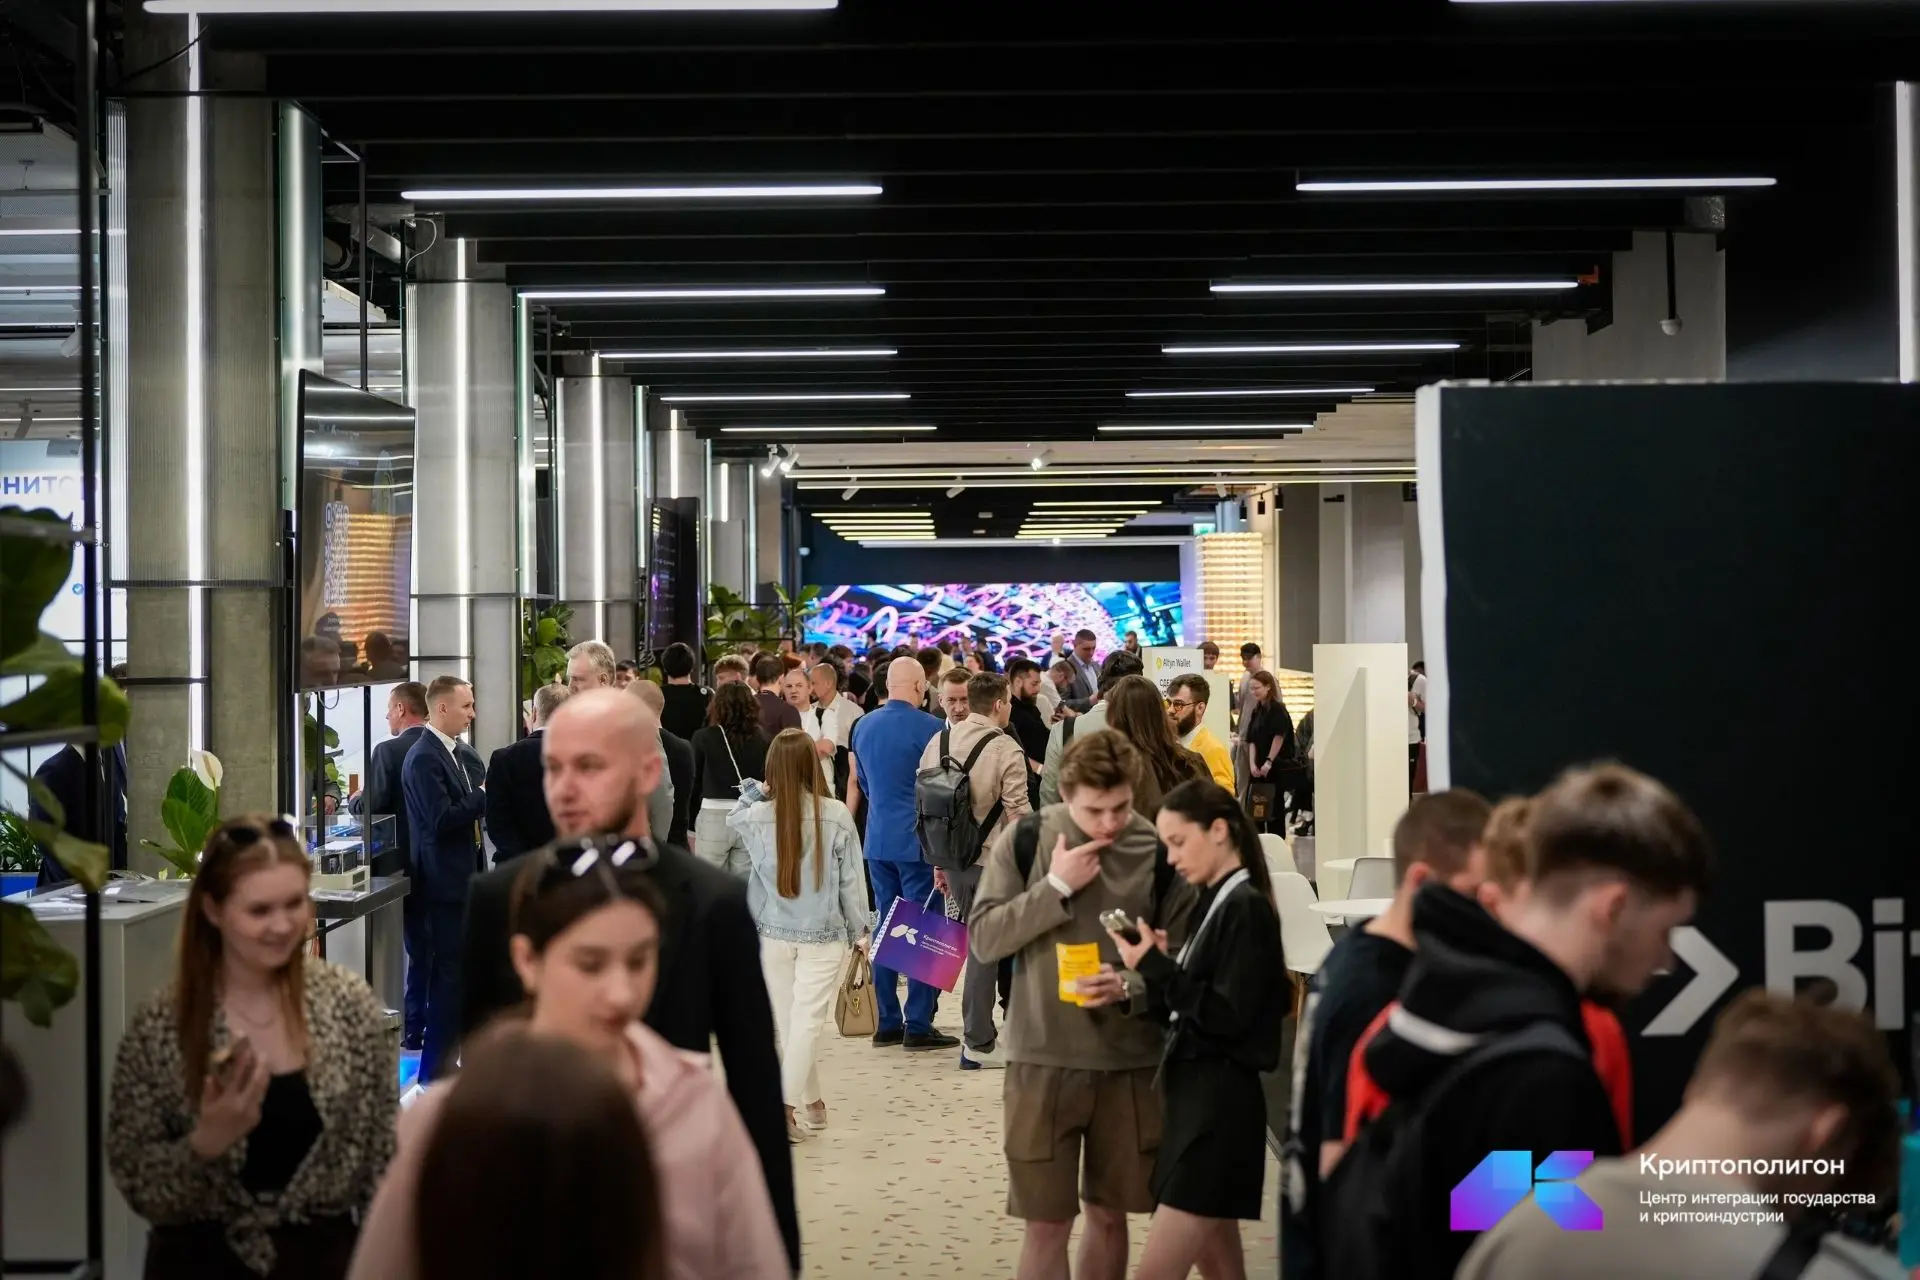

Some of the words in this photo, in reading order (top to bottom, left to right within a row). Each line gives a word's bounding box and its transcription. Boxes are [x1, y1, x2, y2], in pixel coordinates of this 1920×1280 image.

[1163, 658, 1175, 669] Altyn
[1176, 658, 1191, 668] Wallet
[1764, 897, 1920, 1030] Bi
